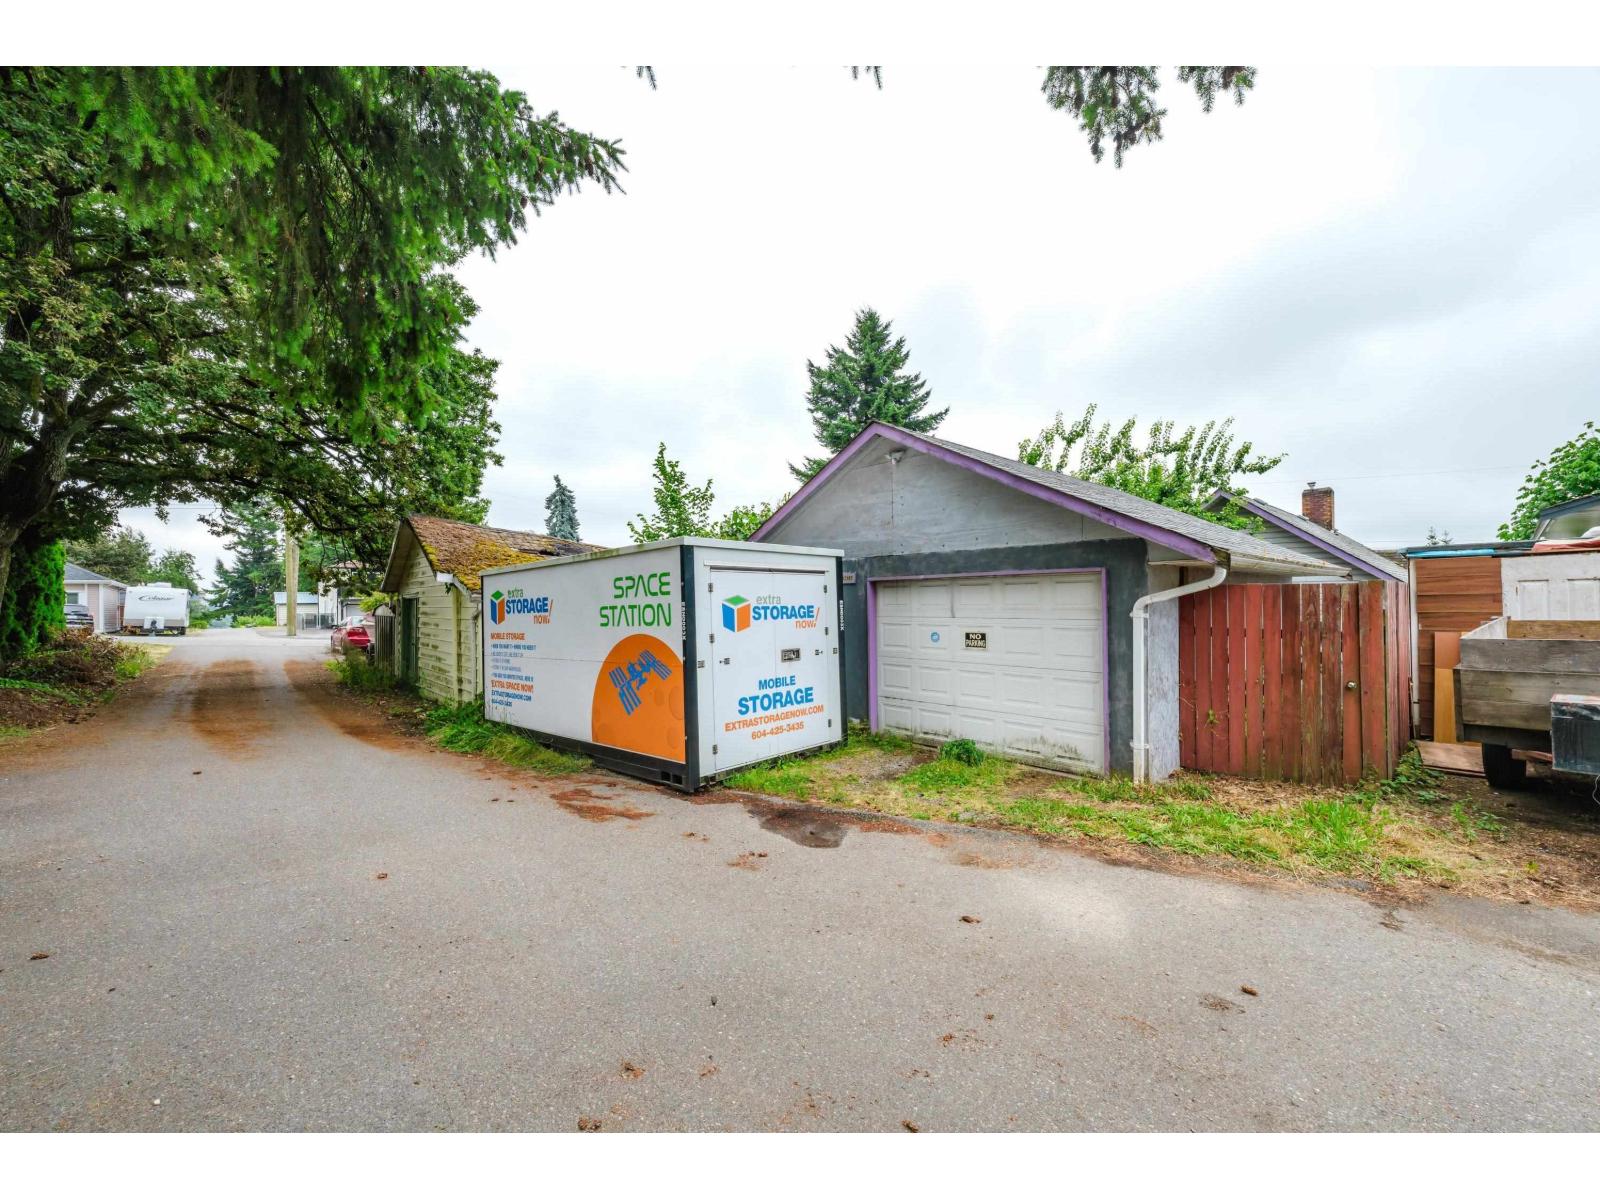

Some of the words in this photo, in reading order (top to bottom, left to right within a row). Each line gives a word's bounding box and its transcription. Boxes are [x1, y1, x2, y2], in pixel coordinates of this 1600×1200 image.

[507, 586, 524, 598] extra
[613, 572, 671, 599] SPACE
[505, 597, 549, 615] STORAGE
[756, 594, 781, 605] extra
[599, 603, 672, 627] STATION
[752, 605, 815, 621] STORAGE
[490, 632, 505, 640] MOBILE
[965, 639, 985, 647] PARKING
[491, 679, 505, 689] EXTRA
[506, 681, 520, 691] SPACE
[758, 675, 796, 690] MOBILE
[737, 687, 814, 716] STORAGE
[724, 704, 824, 732] EXTRASTORAGENOW.COM
[751, 721, 805, 741] 604-425-3435
